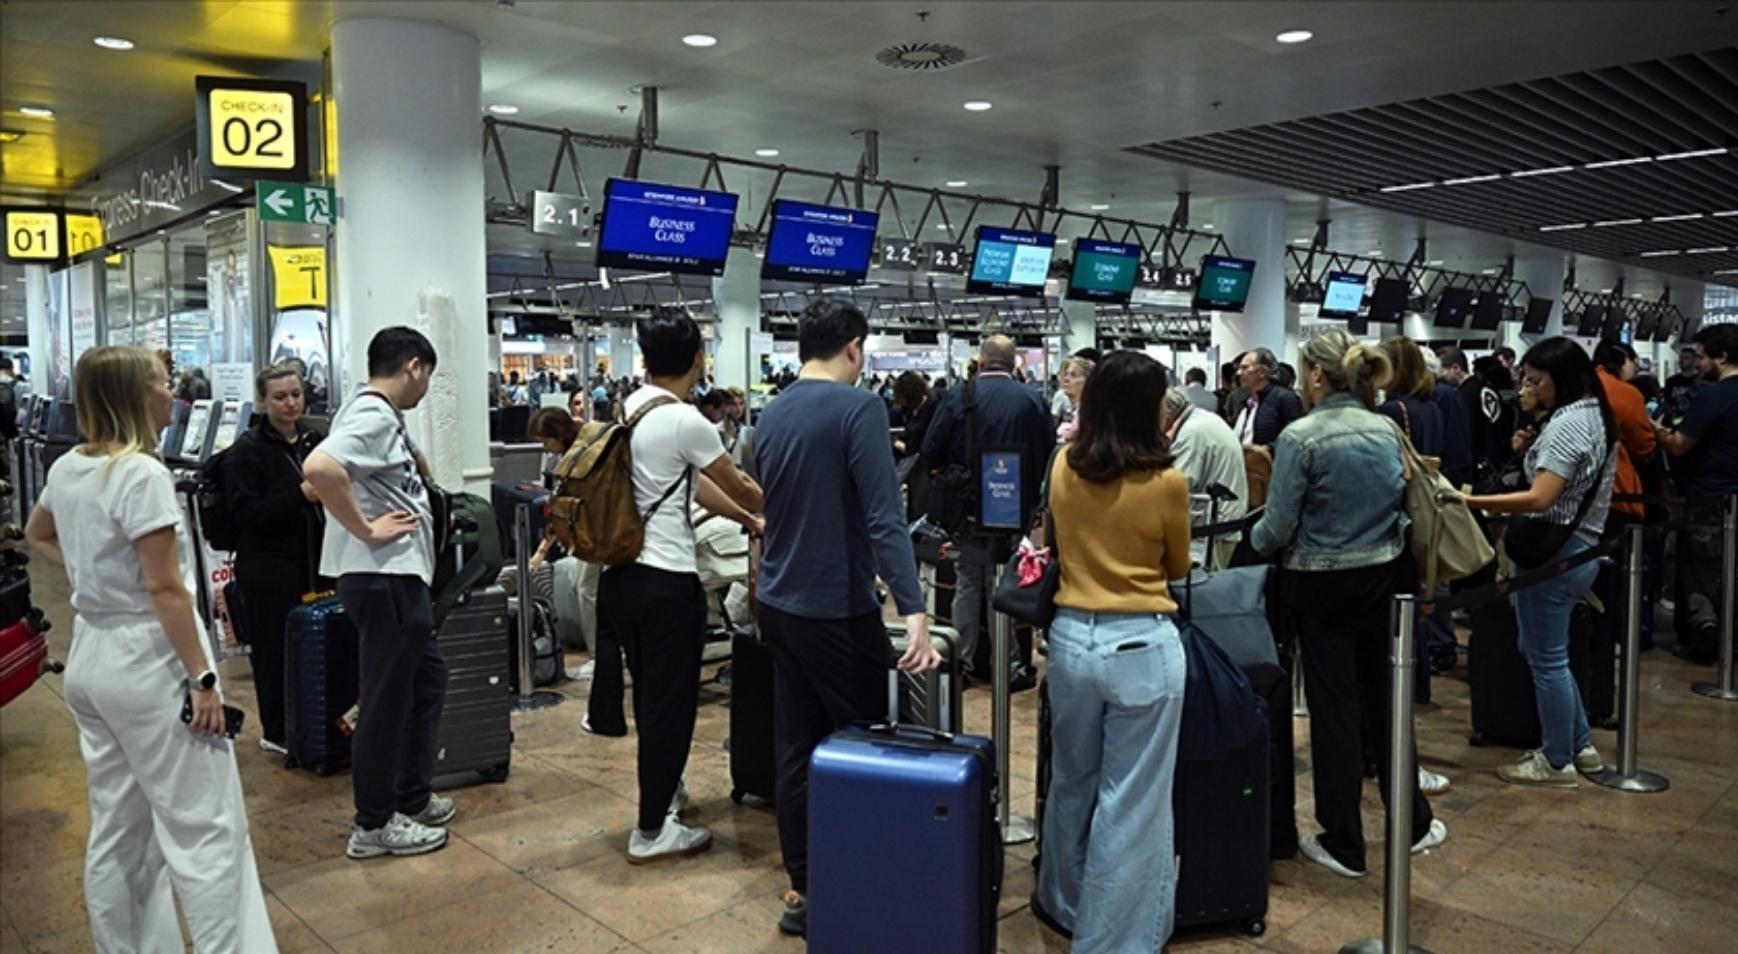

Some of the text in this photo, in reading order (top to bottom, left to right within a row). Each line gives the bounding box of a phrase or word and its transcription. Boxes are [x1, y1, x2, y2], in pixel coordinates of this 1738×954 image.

[221, 100, 283, 113] CHECK-IN
[223, 117, 283, 156] 02
[544, 205, 577, 226] 2.1
[649, 216, 695, 232] BUSINESS
[14, 228, 46, 251] 01
[655, 229, 686, 243] CLASS
[806, 232, 844, 247] BUSINESS
[810, 245, 836, 256] CLASS
[886, 245, 910, 261] 2.2
[936, 250, 958, 266] 2.3
